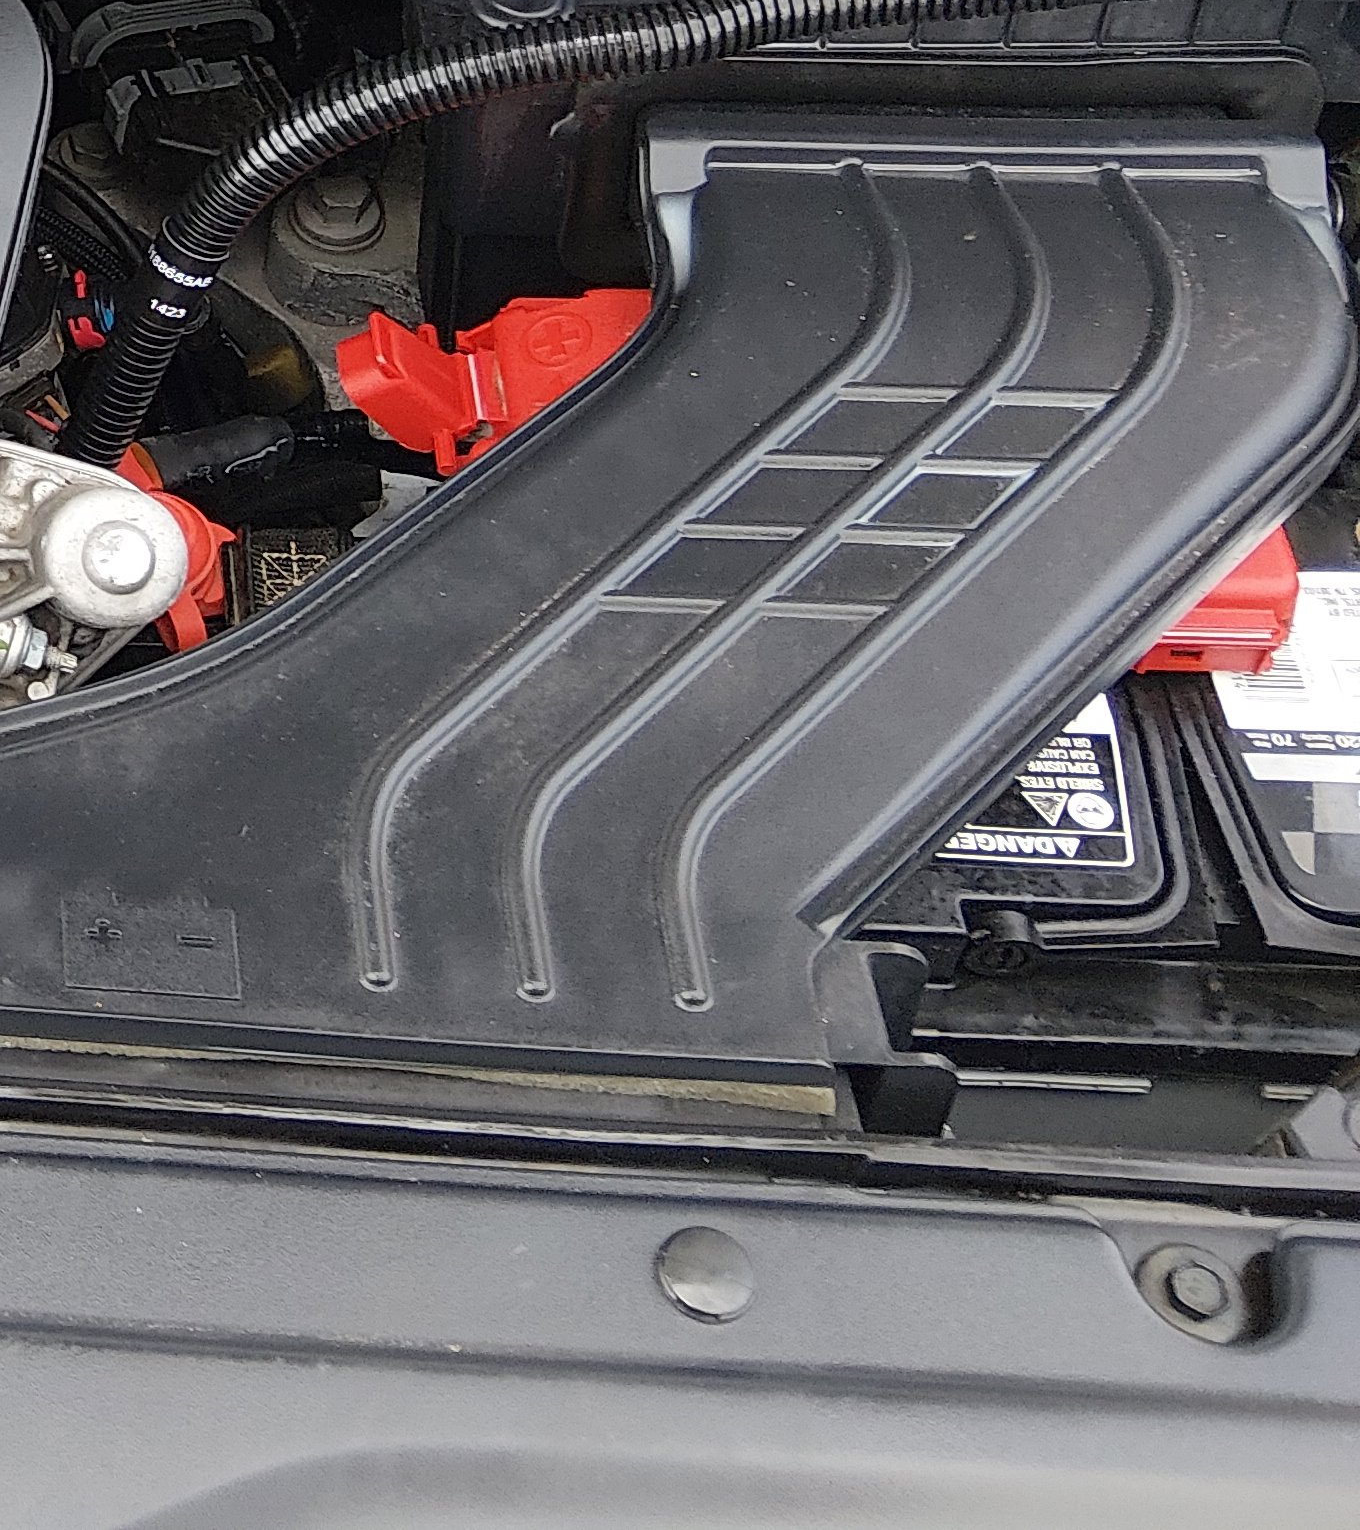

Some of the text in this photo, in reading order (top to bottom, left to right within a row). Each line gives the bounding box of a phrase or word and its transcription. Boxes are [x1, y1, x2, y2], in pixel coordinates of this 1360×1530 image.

[1072, 737, 1092, 749] OR
[1270, 733, 1298, 747] 70
[1070, 750, 1095, 760] CAN
[1056, 776, 1105, 791] SHIELD
